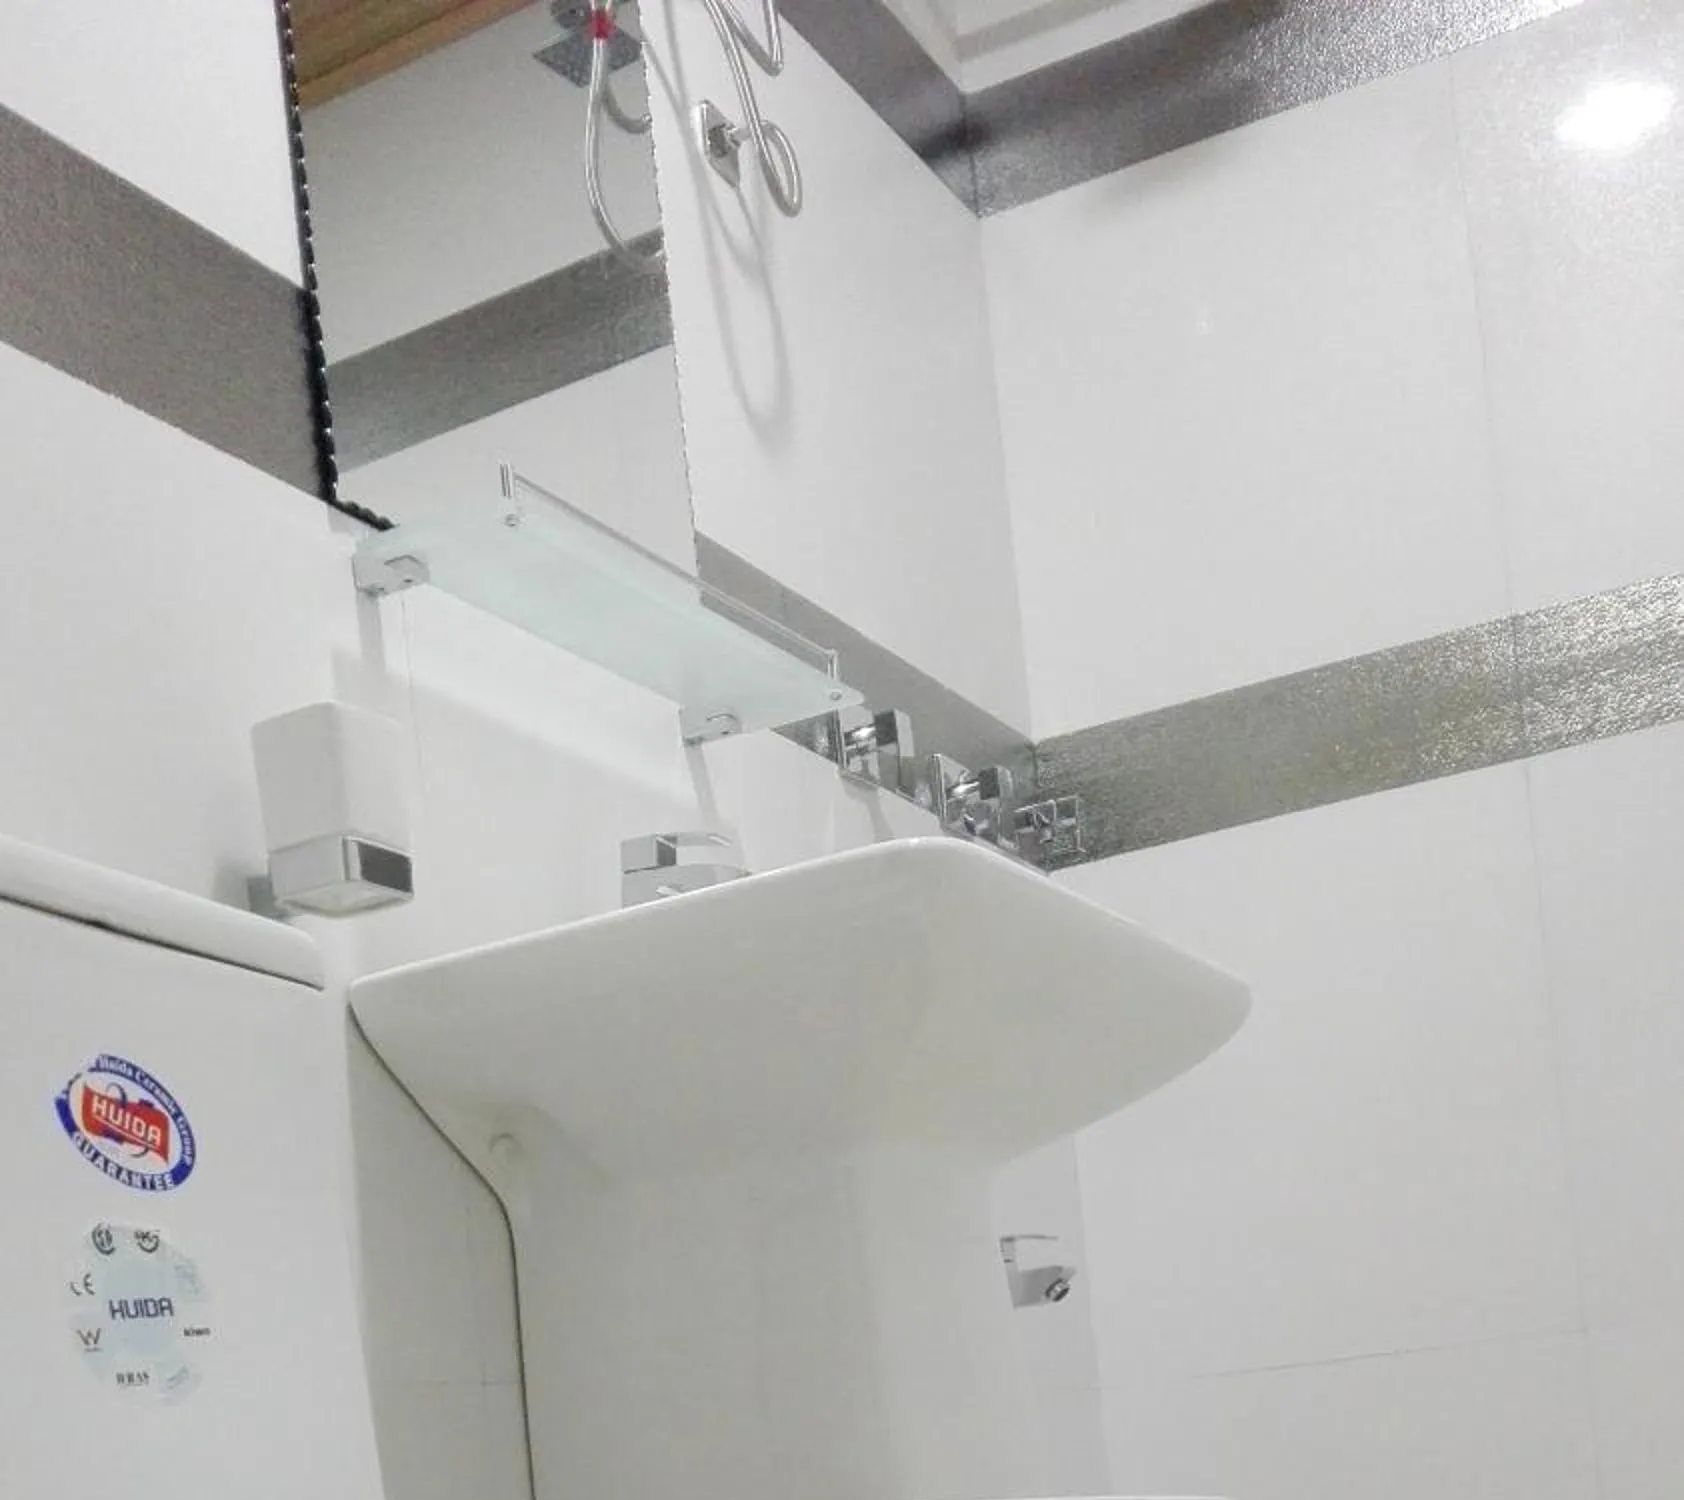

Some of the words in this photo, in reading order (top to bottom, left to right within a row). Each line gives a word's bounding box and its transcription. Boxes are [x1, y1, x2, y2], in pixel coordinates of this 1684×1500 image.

[91, 1094, 163, 1147] HUIDA
[71, 1131, 175, 1191] GUARANTEE
[108, 1297, 175, 1321] HUIDA
